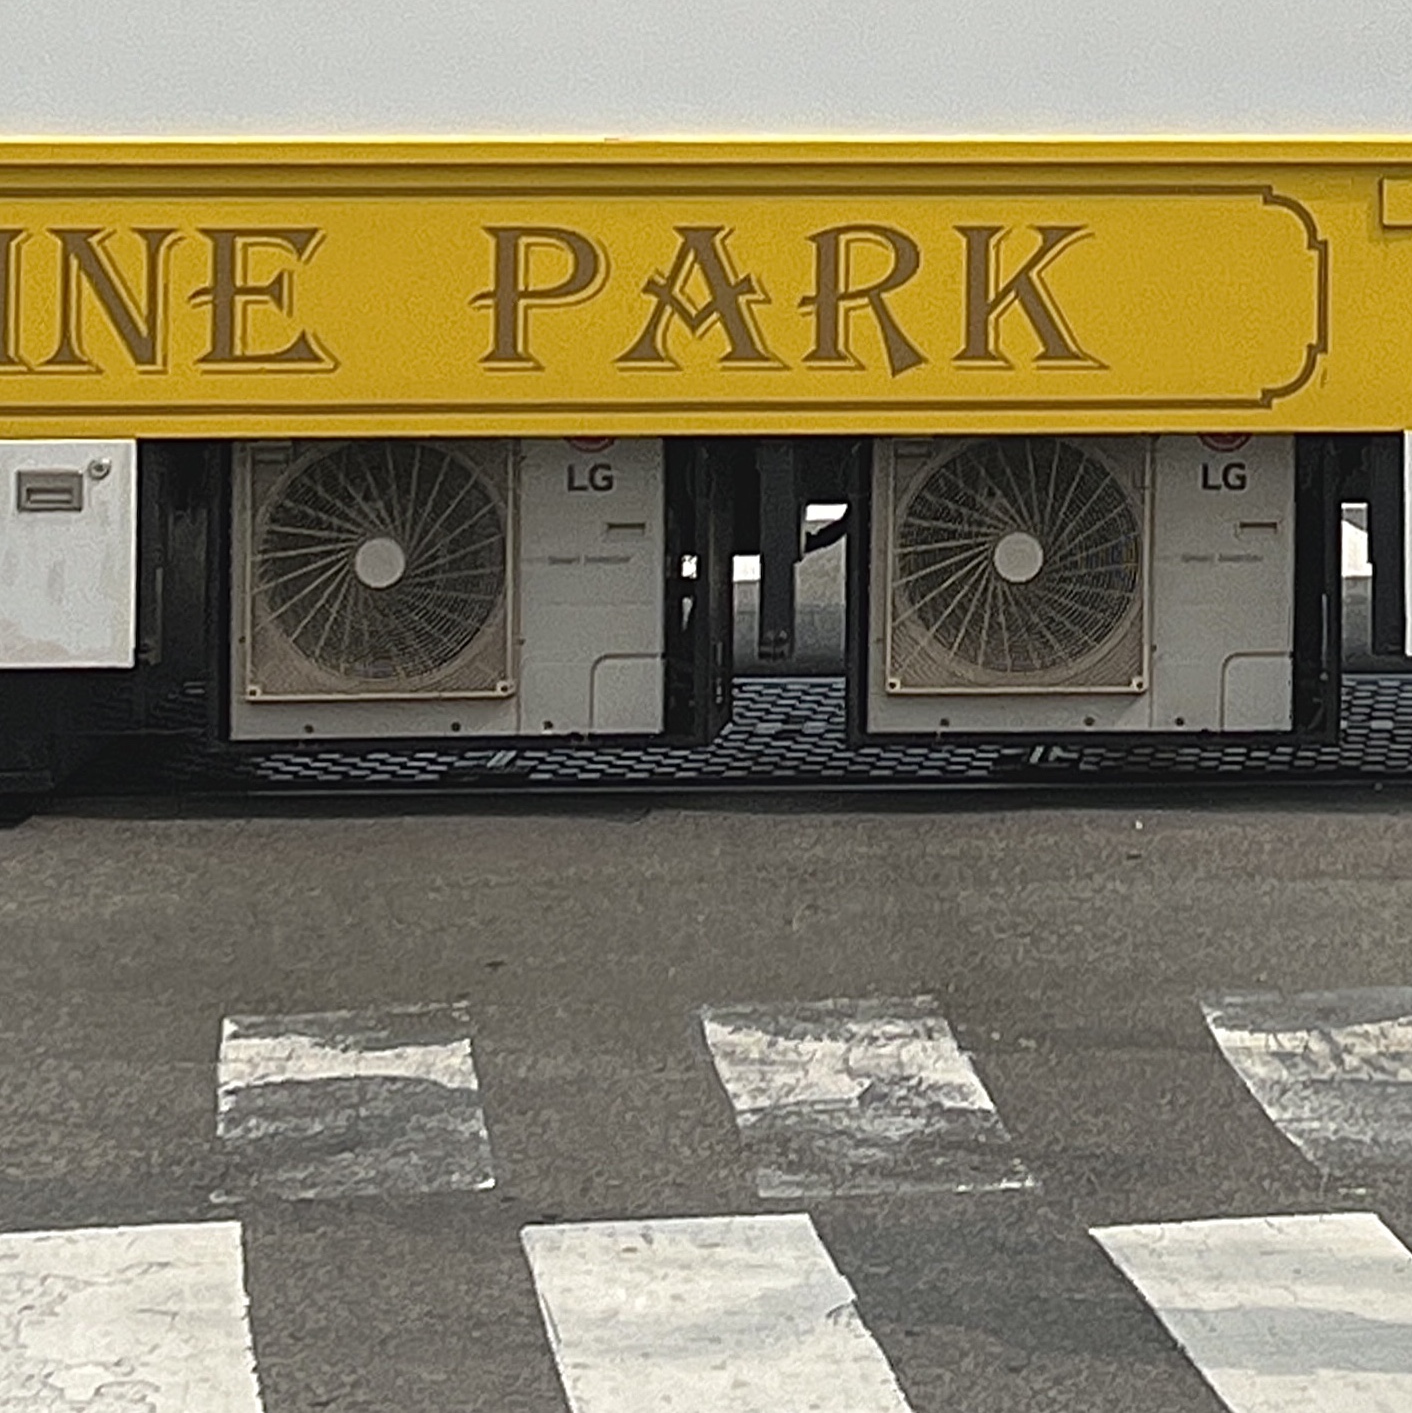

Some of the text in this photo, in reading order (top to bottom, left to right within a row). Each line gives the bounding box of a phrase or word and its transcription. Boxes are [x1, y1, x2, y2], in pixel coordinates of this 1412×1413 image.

[468, 222, 1110, 378] PARK
[566, 463, 614, 493] LG
[1201, 461, 1248, 491] LG
